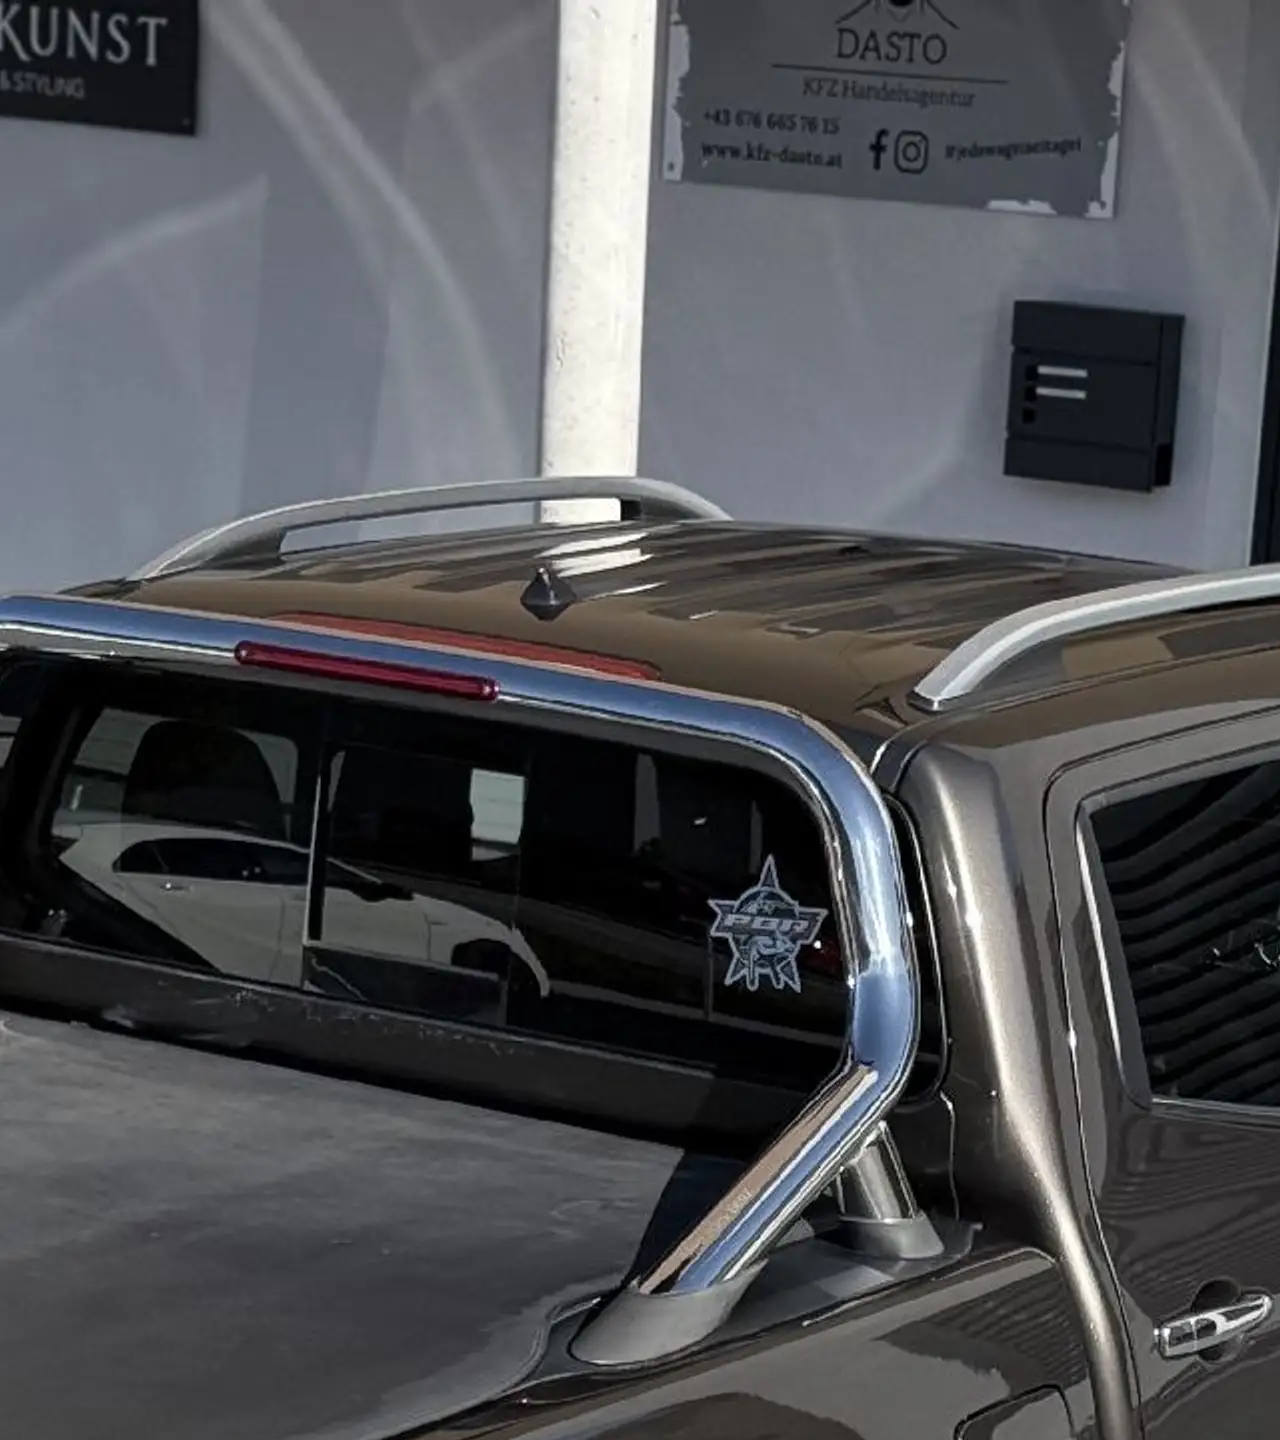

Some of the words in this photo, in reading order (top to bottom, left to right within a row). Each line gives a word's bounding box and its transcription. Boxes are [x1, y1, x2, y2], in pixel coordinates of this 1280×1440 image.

[836, 26, 949, 66] DASTO
[12, 70, 85, 98] STYLING
[802, 77, 839, 98] KFZ
